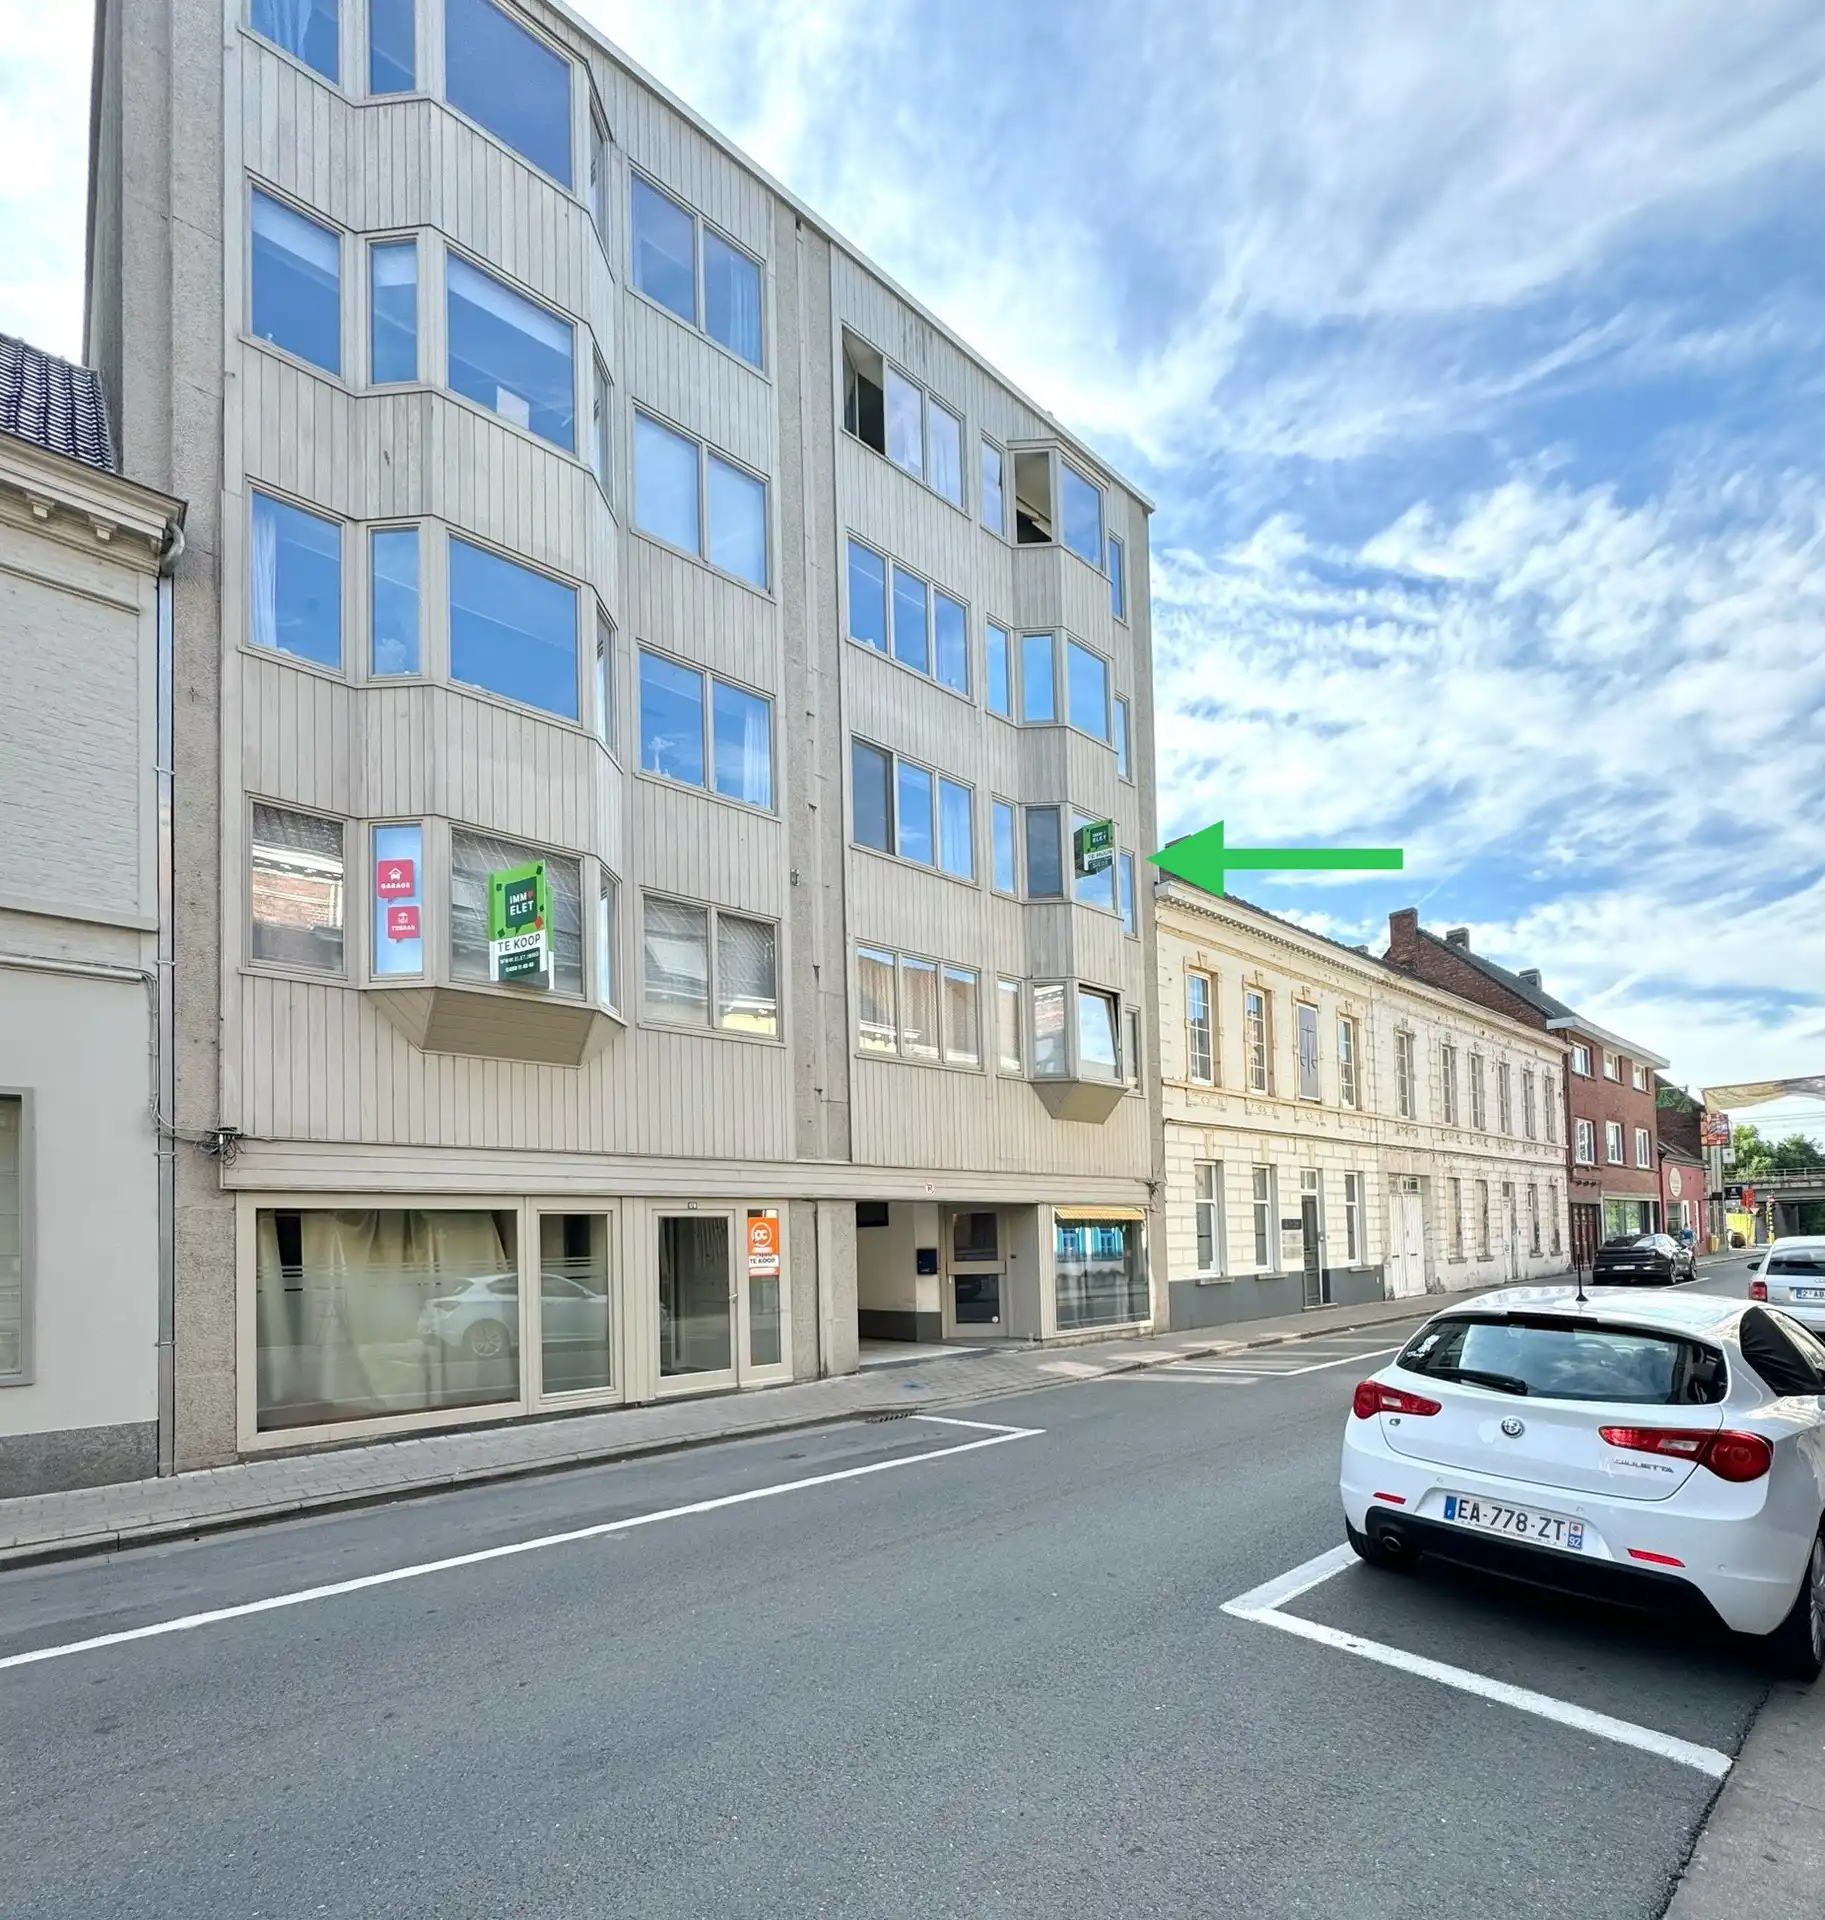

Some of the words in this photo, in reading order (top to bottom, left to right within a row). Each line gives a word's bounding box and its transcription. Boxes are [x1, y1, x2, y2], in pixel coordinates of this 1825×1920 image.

[380, 881, 411, 890] GARAGE
[509, 900, 534, 916] ELET
[498, 941, 511, 952] TE
[513, 933, 541, 949] KOOP
[1458, 1499, 1565, 1541] EA-778-ZT
[1568, 1536, 1581, 1548] 92
